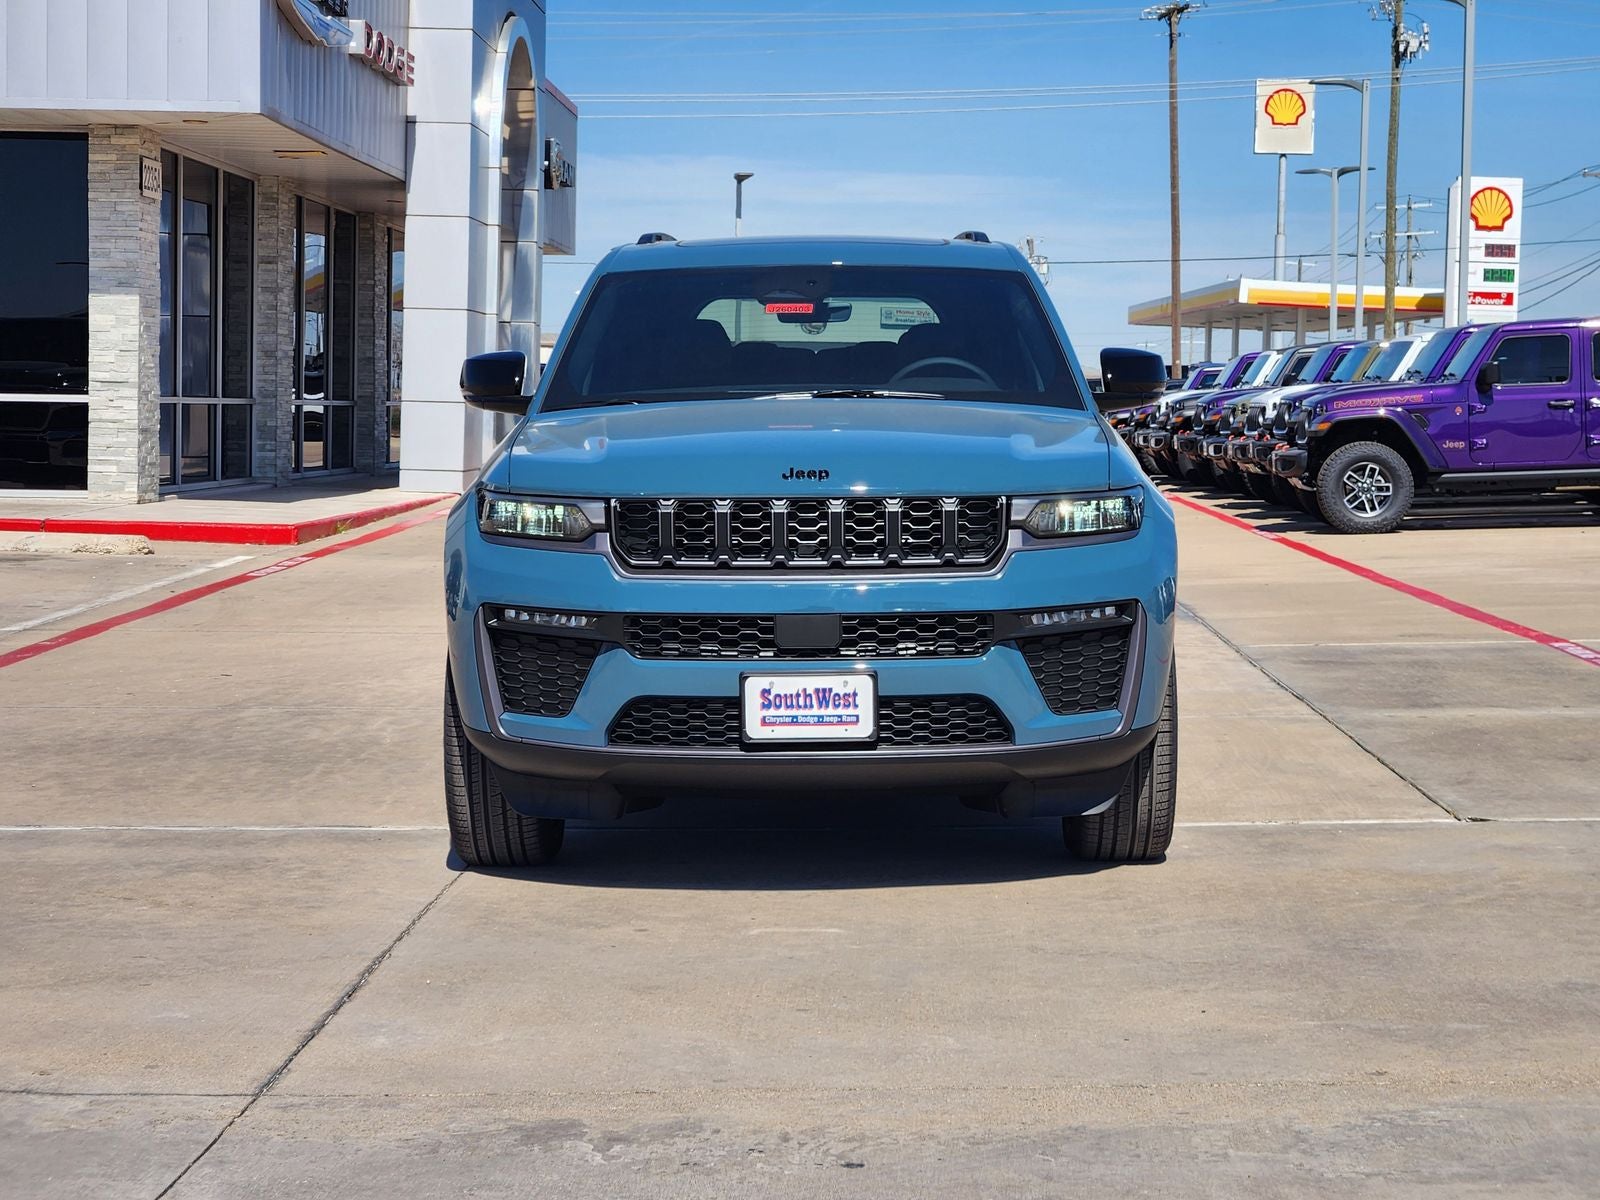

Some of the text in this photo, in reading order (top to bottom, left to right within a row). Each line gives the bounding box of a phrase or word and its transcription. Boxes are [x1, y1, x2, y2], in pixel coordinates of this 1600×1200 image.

[364, 20, 415, 87] DODGE
[1333, 394, 1424, 409] MOJAVE
[1442, 439, 1465, 450] Jeep
[781, 467, 830, 482] Jeep
[760, 687, 859, 711] SouthWest
[765, 715, 792, 724] Chrysler
[797, 715, 818, 724] Dodge
[823, 715, 838, 723] Jeep
